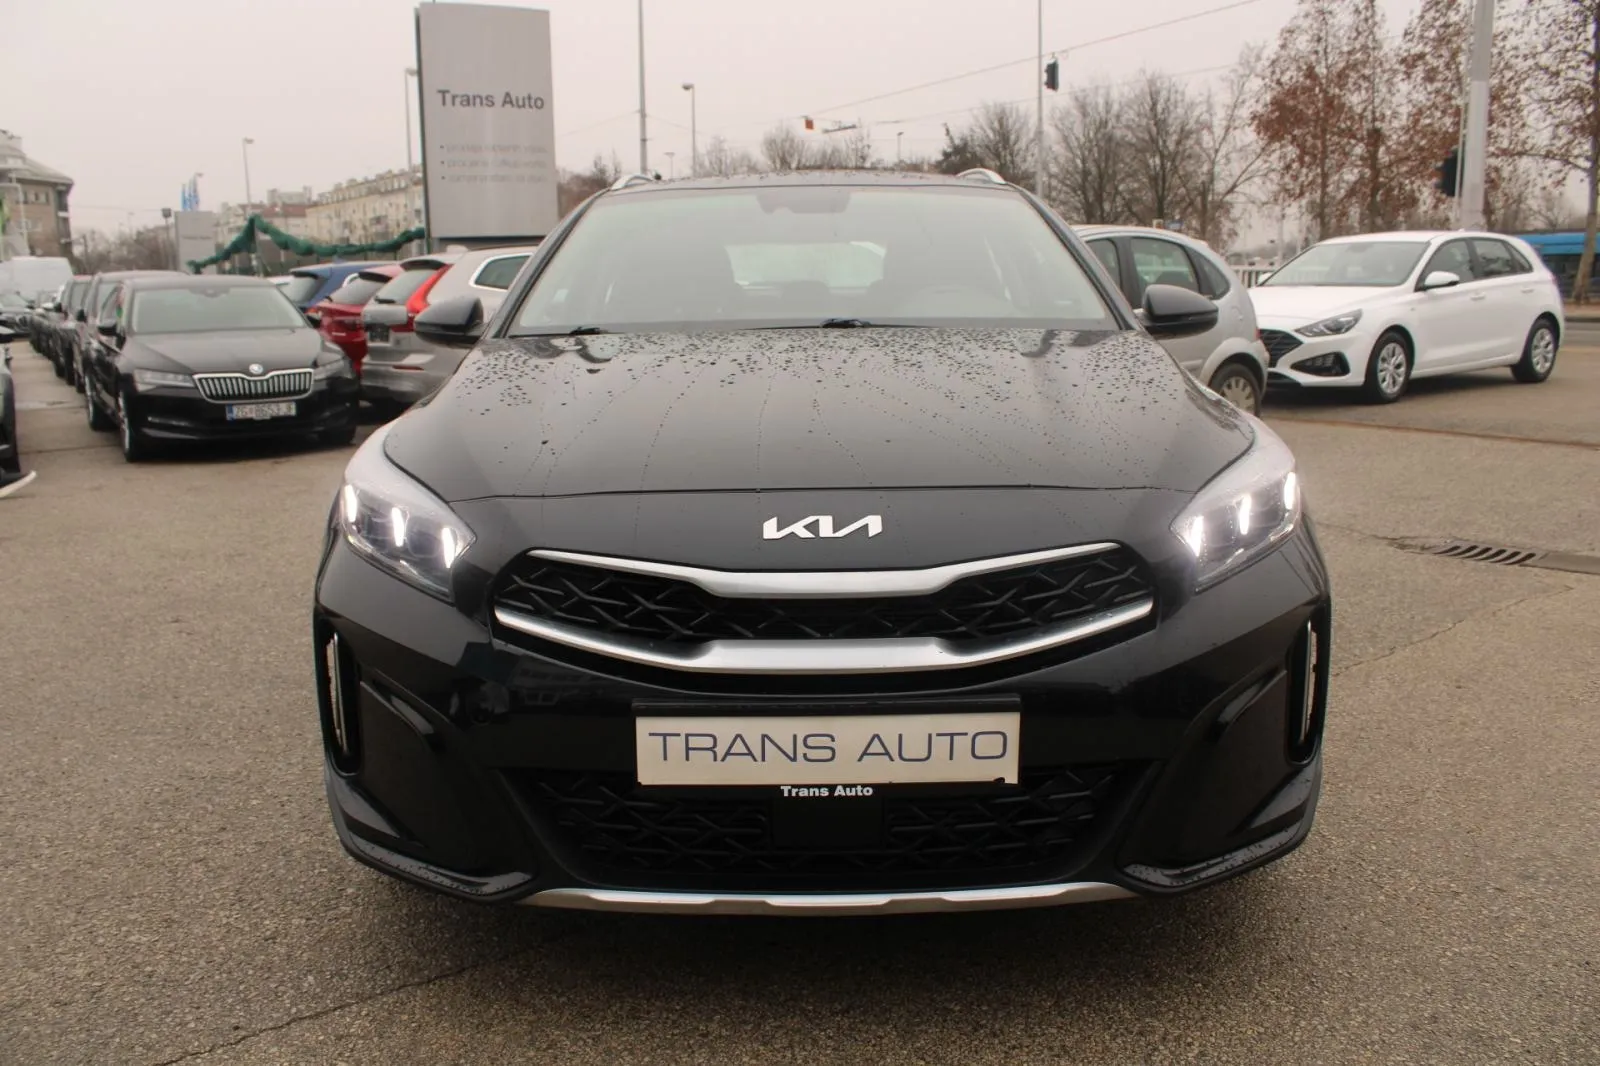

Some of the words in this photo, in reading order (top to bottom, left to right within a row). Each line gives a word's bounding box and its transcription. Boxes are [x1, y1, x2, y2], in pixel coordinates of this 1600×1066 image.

[437, 89, 495, 108] Trans
[501, 91, 545, 110] Auto
[763, 515, 883, 540] KIA
[648, 732, 836, 763] TRANS
[857, 730, 1008, 762] AUTO
[780, 785, 829, 797] Trans
[834, 784, 873, 797] Auto
